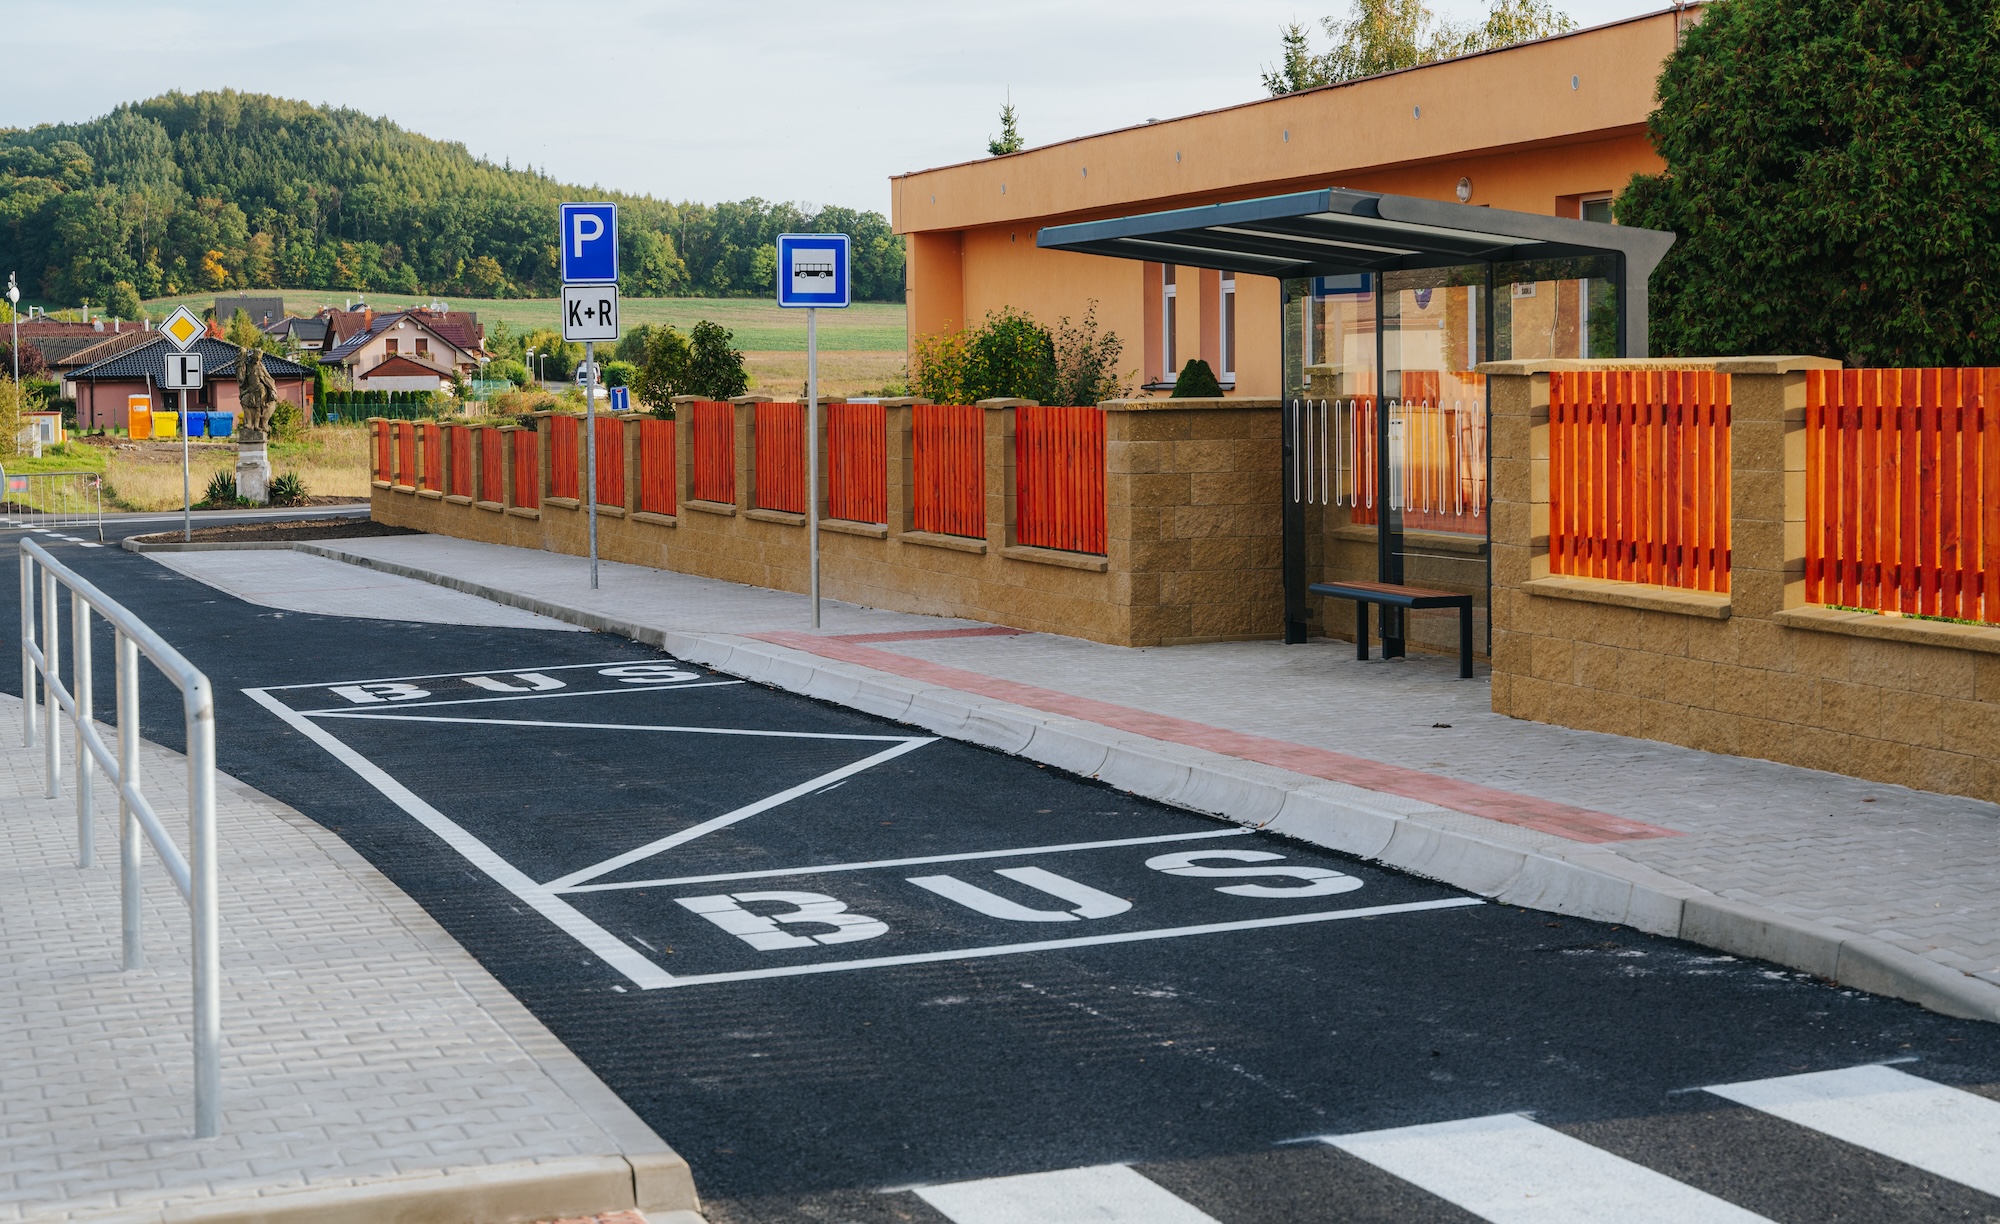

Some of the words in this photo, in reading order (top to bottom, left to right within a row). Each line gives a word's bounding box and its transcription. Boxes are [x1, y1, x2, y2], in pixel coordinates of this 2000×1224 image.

[573, 213, 605, 258] P
[568, 299, 613, 327] K+R
[327, 665, 701, 704] BUS
[673, 849, 1365, 952] BUS
